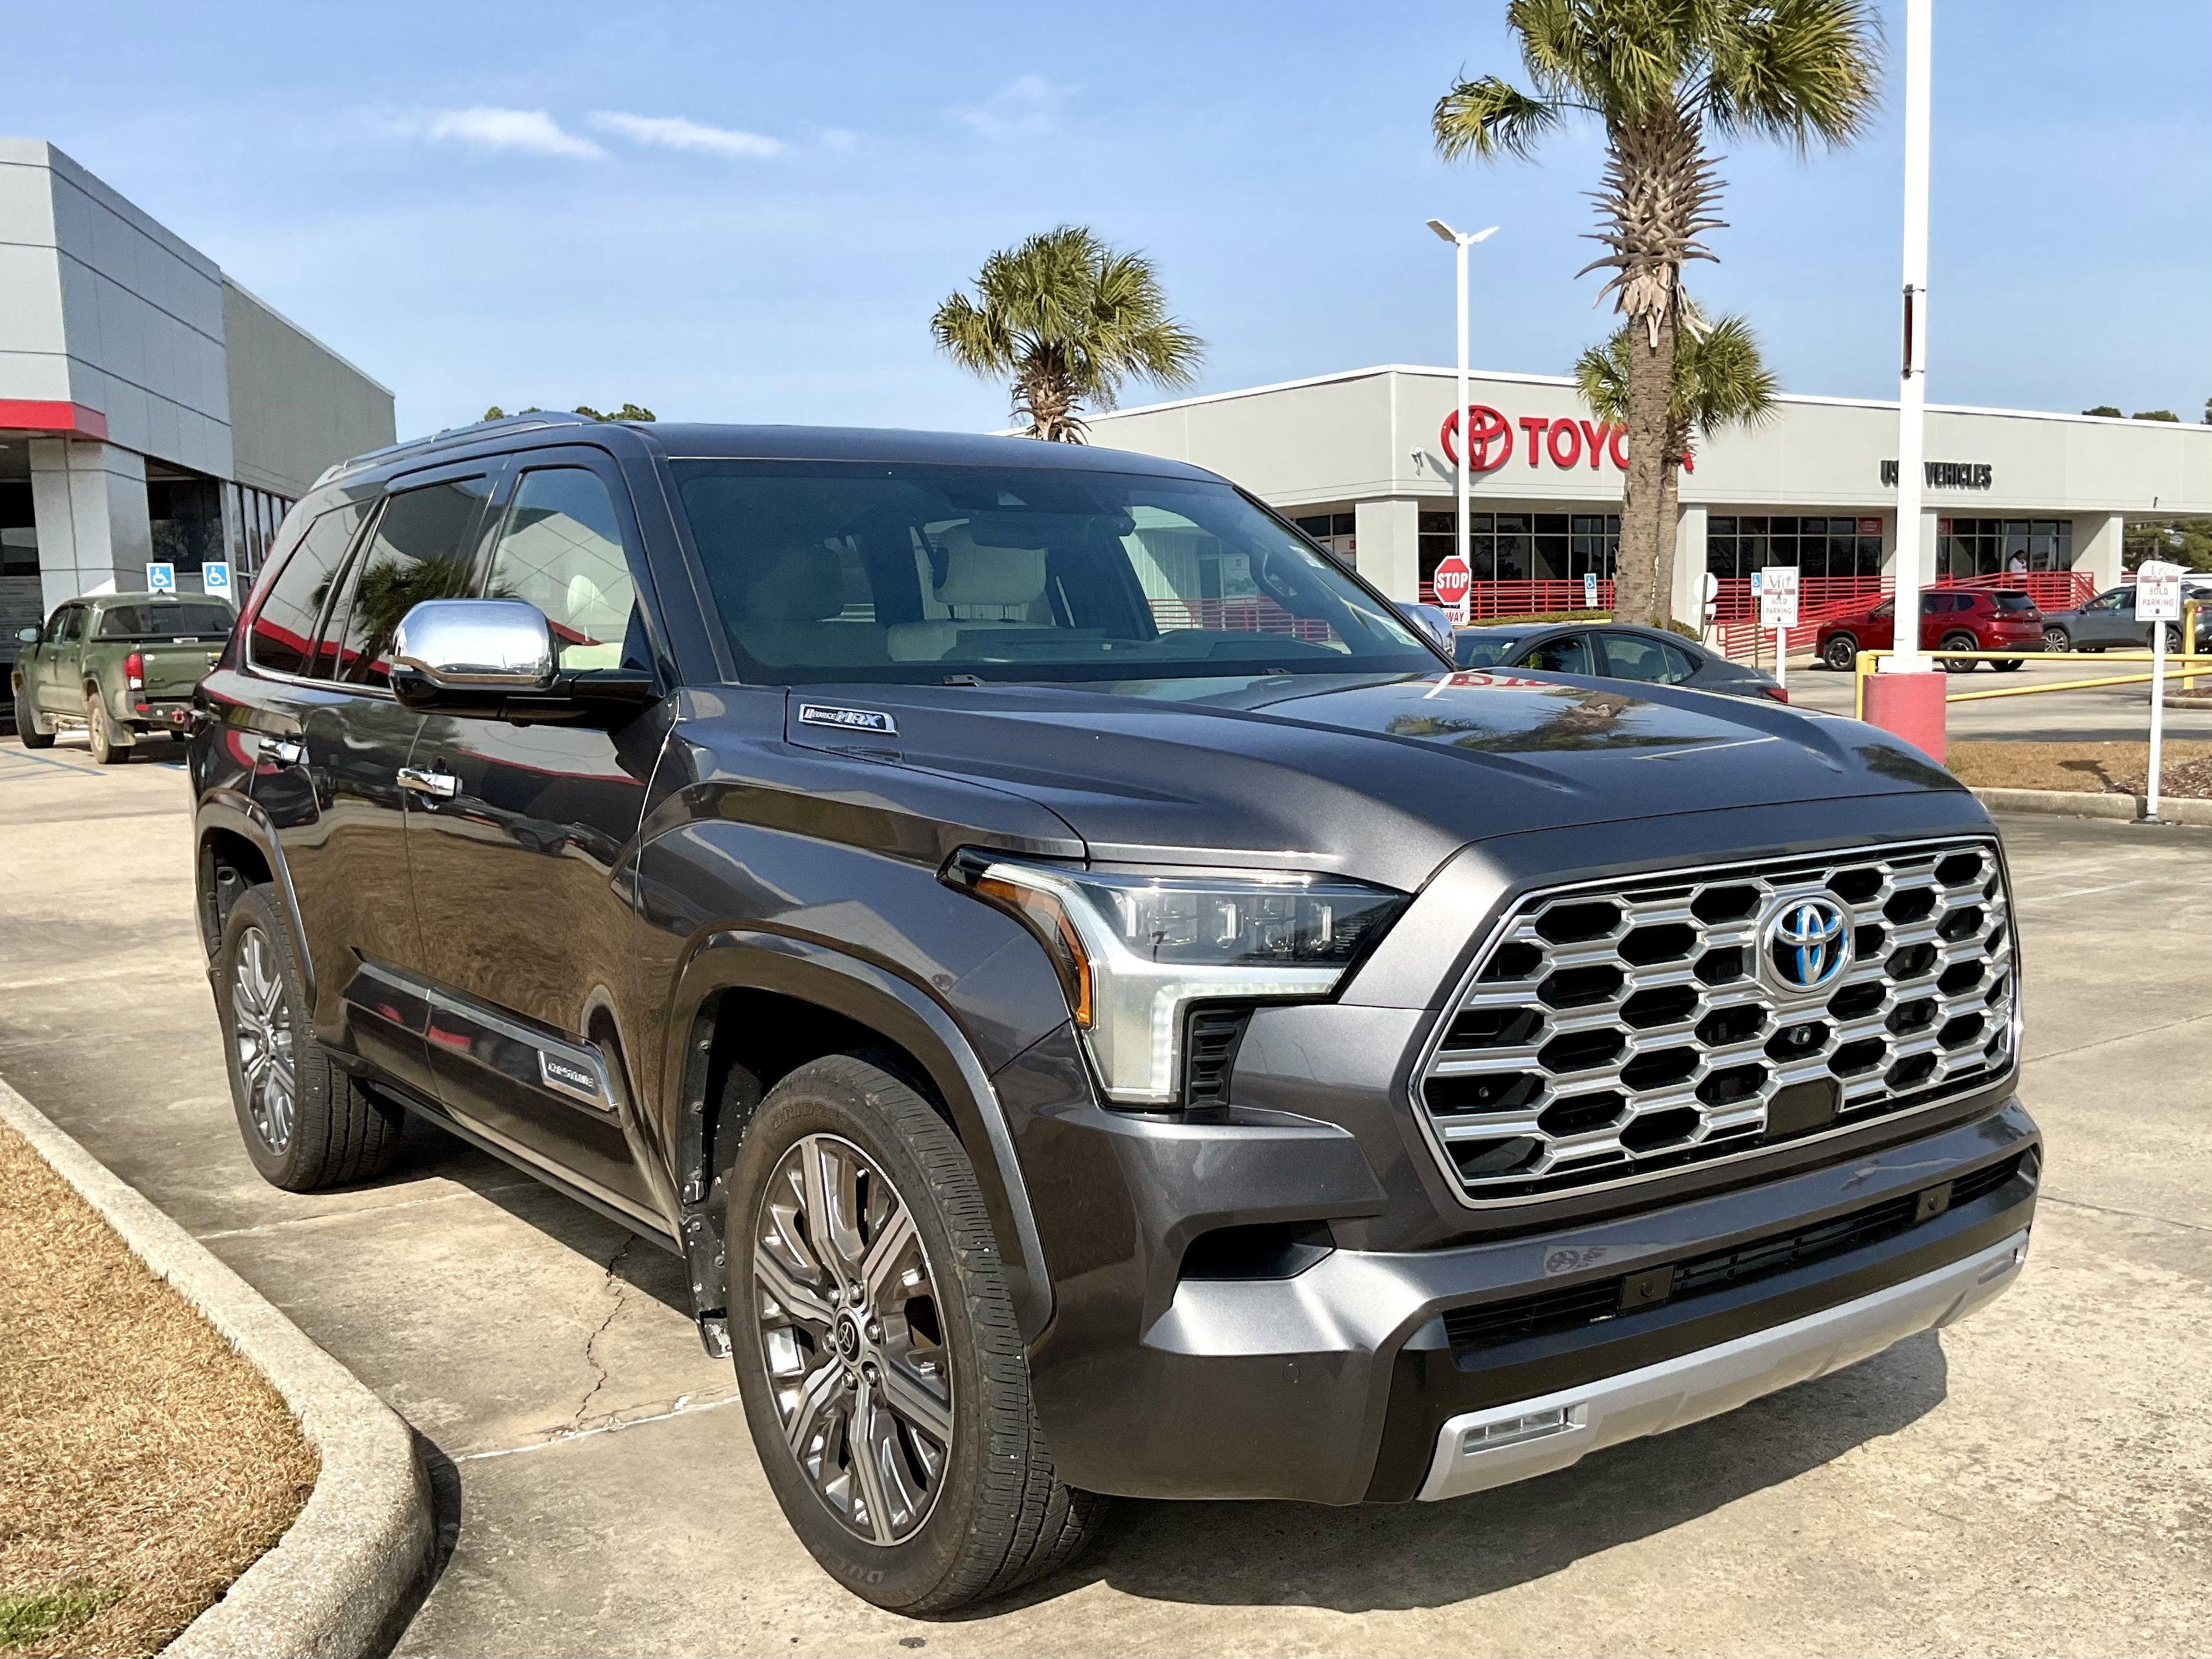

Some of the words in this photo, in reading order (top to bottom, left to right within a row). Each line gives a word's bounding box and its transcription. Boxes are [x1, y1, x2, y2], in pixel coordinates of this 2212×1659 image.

[1519, 417, 1694, 471] TOYO
[1924, 462, 1992, 488] VEHICLES
[1437, 572, 1468, 589] STOP
[2142, 598, 2174, 606] PARKING
